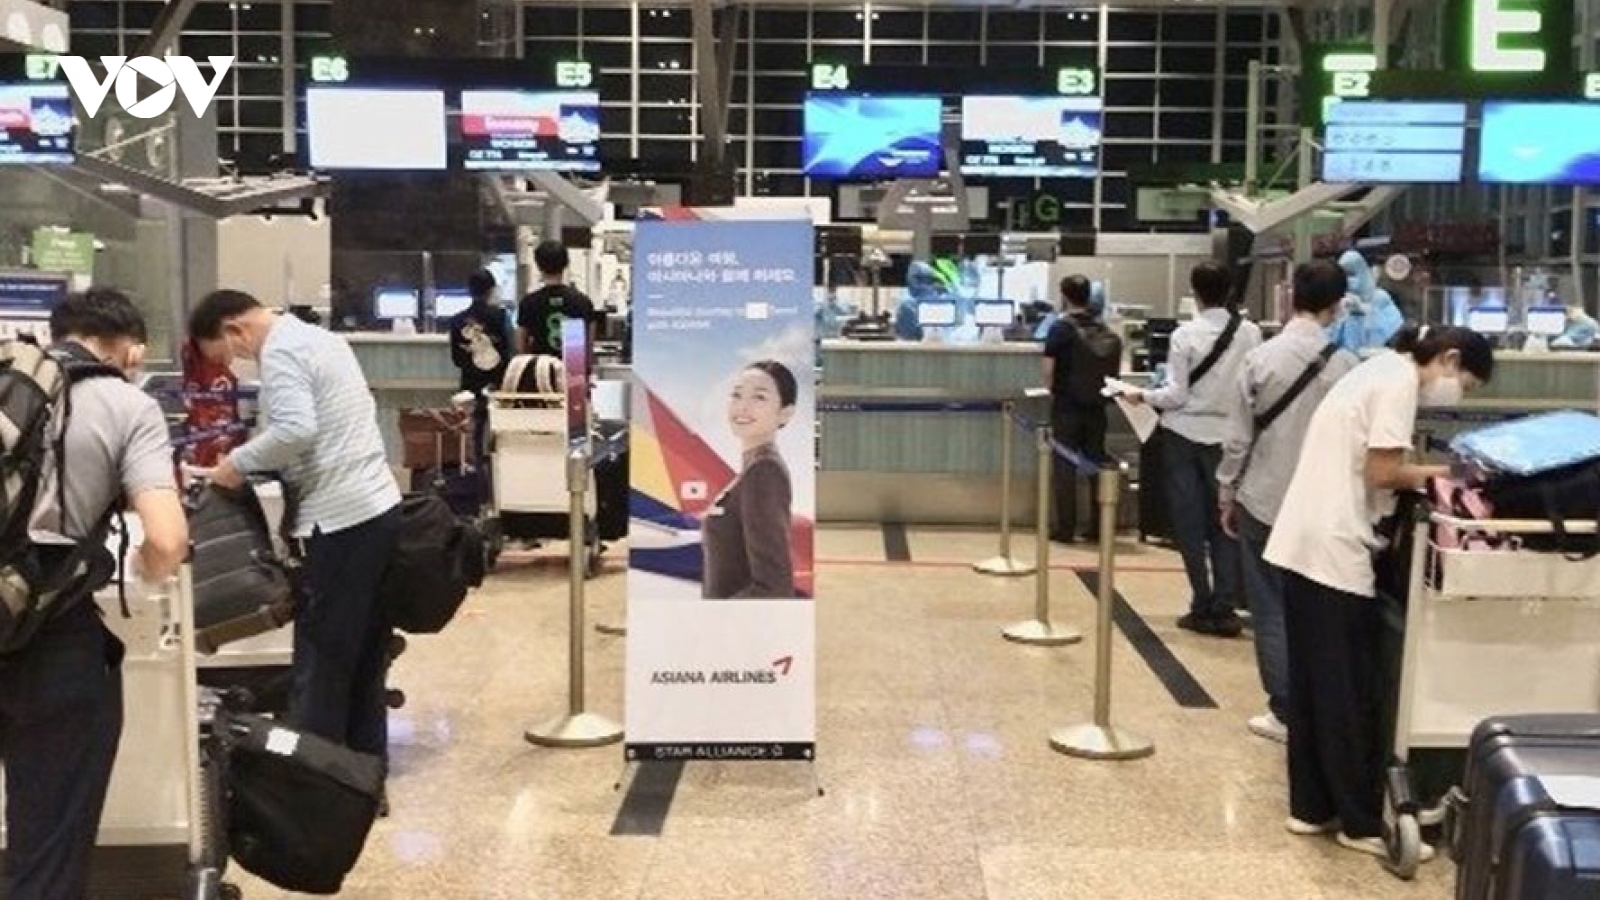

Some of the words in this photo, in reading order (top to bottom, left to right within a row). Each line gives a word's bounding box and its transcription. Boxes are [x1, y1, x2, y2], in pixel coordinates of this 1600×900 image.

[1470, 0, 1546, 72] E
[26, 54, 60, 79] E7
[311, 56, 349, 82] E6
[556, 61, 592, 87] E5
[811, 63, 849, 89] E4
[1057, 67, 1095, 94] E3
[1332, 71, 1371, 97] E2
[650, 670, 706, 685] ASIANA
[709, 670, 777, 685] AIRLINES
[653, 745, 693, 758] STAR
[695, 745, 767, 758] ALLIANCE
